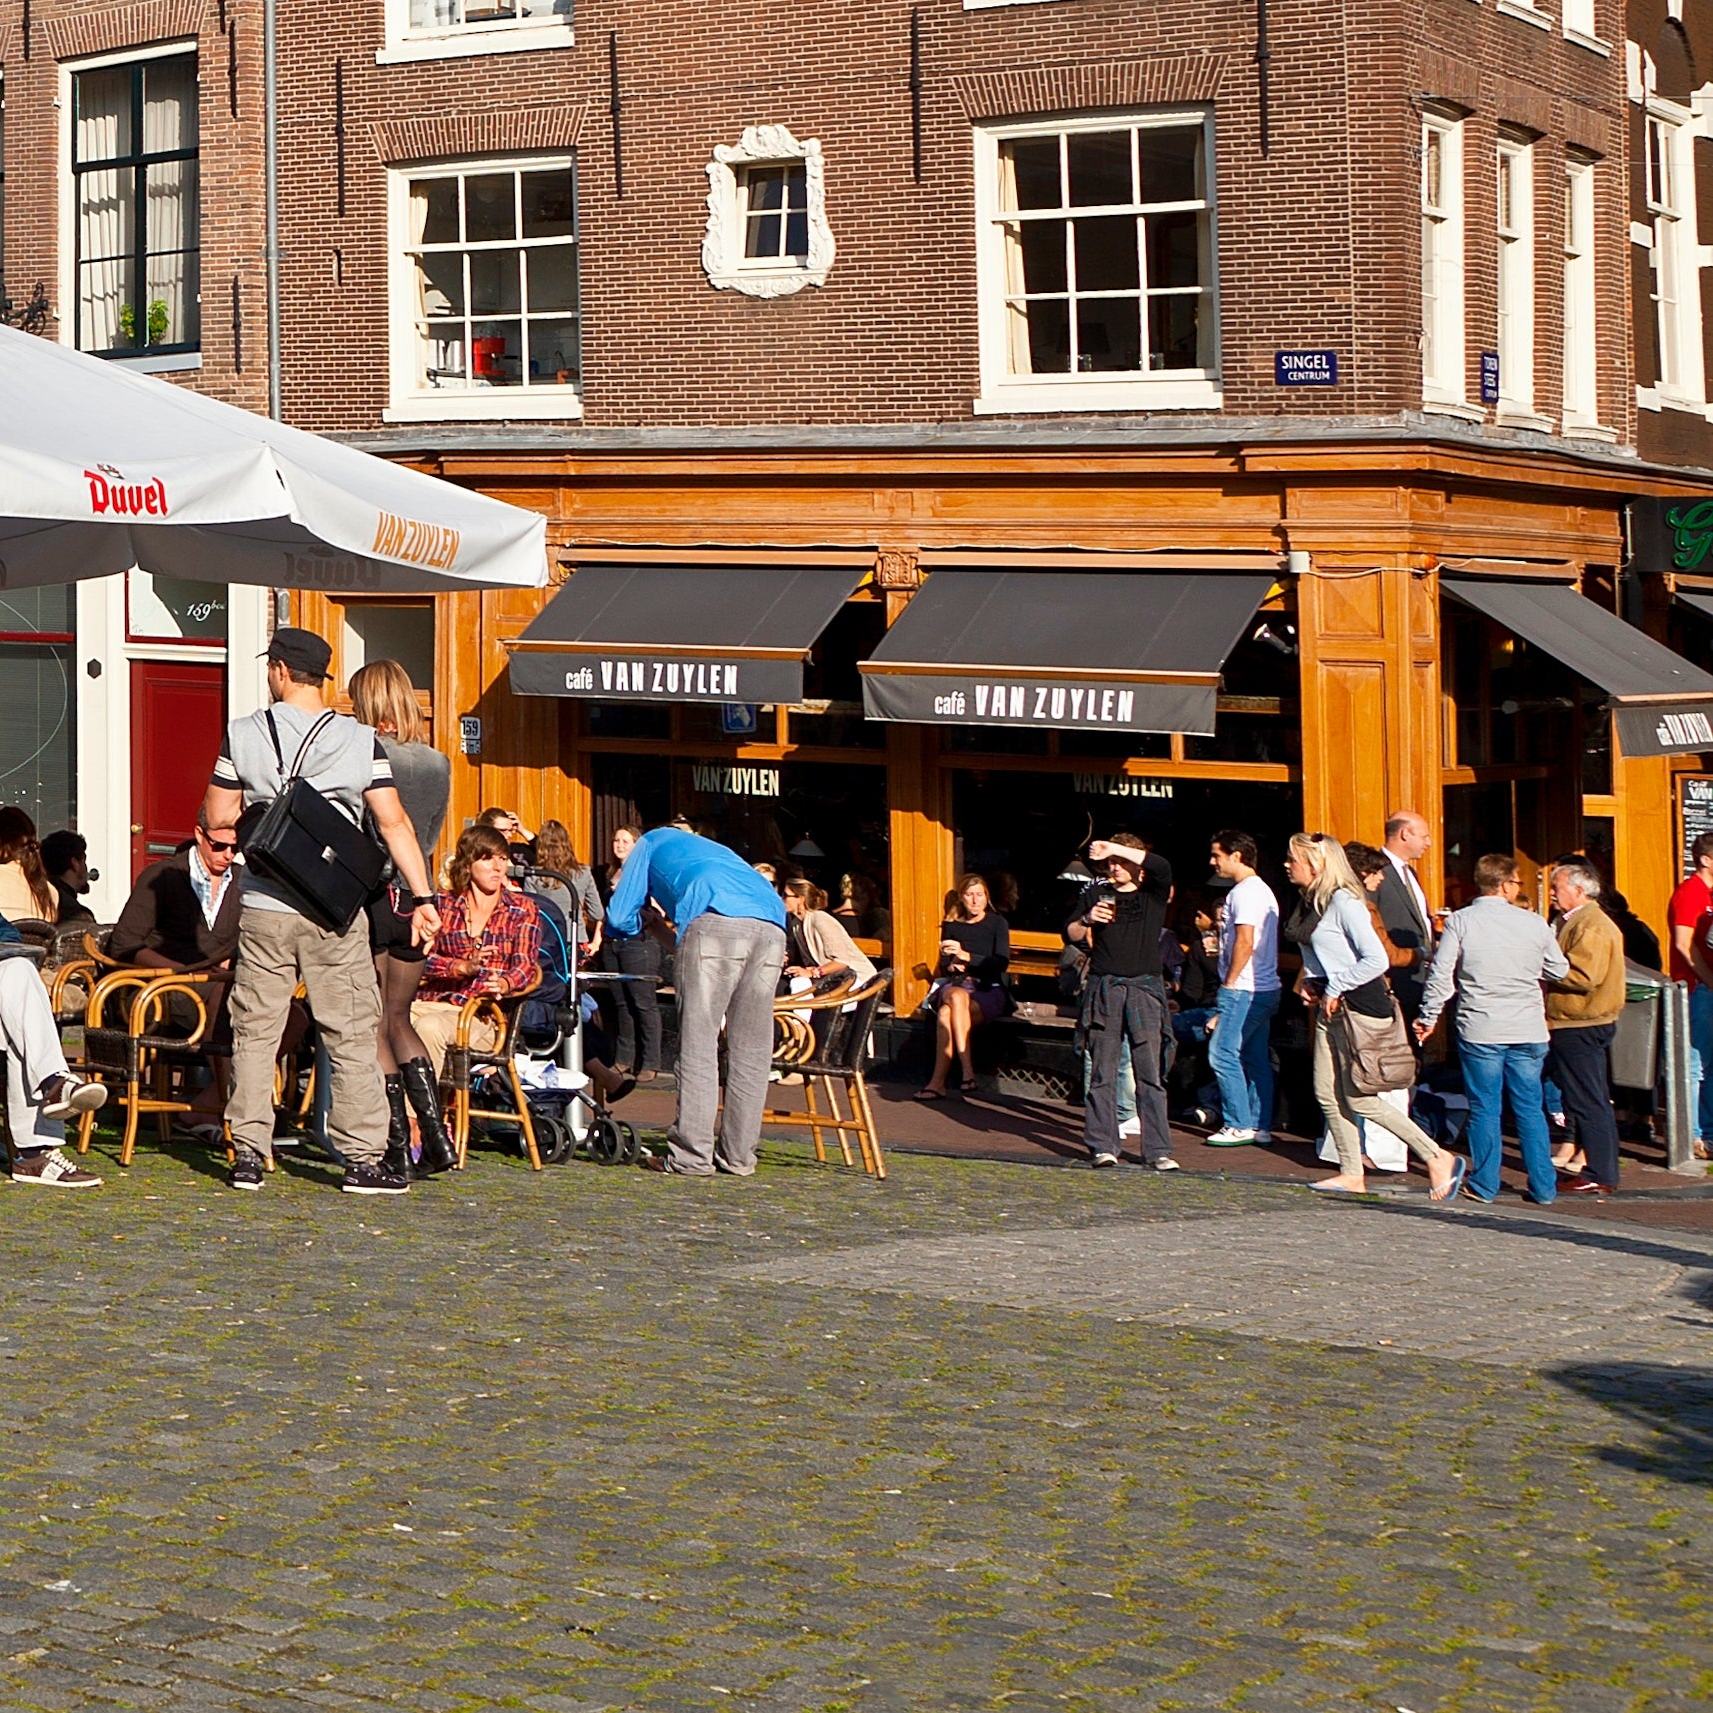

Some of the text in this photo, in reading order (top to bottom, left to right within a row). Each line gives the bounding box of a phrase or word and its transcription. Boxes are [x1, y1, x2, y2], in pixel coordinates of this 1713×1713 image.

[1281, 355, 1329, 369] SINGEL
[1288, 371, 1330, 380] CENTRUM
[84, 470, 168, 516] Duvel
[372, 511, 460, 570] VAN ZUYLEN
[565, 661, 738, 695] café VAN ZUYLEN
[934, 685, 1134, 722] café VAN ZUYLEN
[461, 719, 478, 736] 159
[692, 767, 779, 796] VAN ZUYLEN
